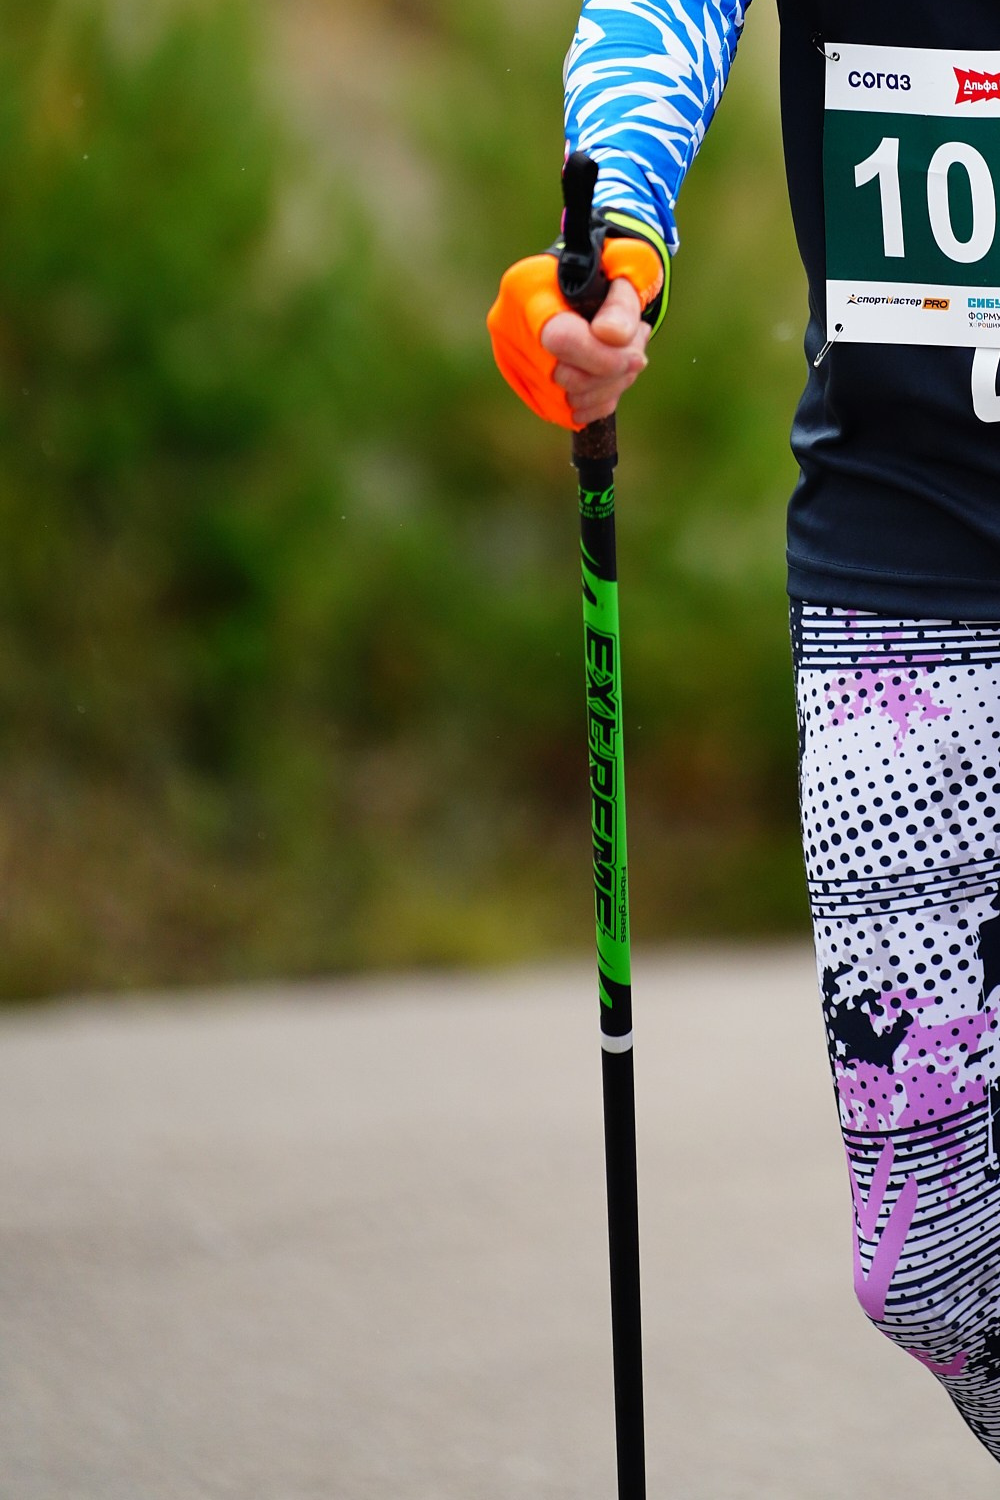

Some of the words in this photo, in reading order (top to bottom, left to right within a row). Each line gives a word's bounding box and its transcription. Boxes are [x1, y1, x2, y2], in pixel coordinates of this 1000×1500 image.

[963, 79, 998, 94] Альфа
[923, 299, 948, 309] PRO
[618, 866, 628, 944] Fiberglass
